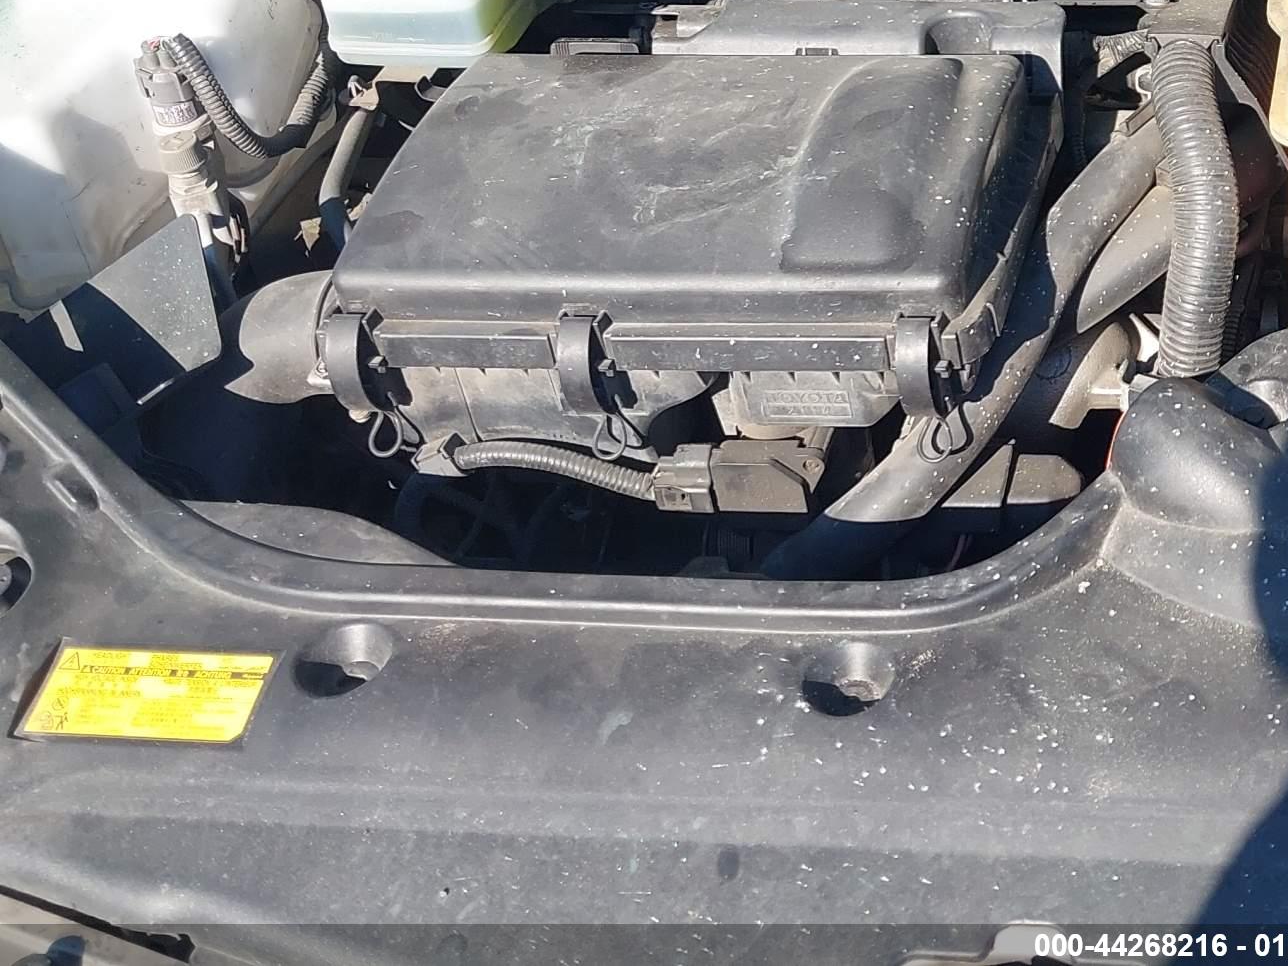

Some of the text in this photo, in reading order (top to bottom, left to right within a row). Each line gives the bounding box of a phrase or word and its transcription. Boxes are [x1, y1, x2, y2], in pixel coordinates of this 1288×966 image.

[766, 392, 849, 404] TOYOTA
[91, 665, 125, 674] CAUTION
[129, 667, 171, 677] ATTENTION
[194, 671, 231, 679] ACHTUNG
